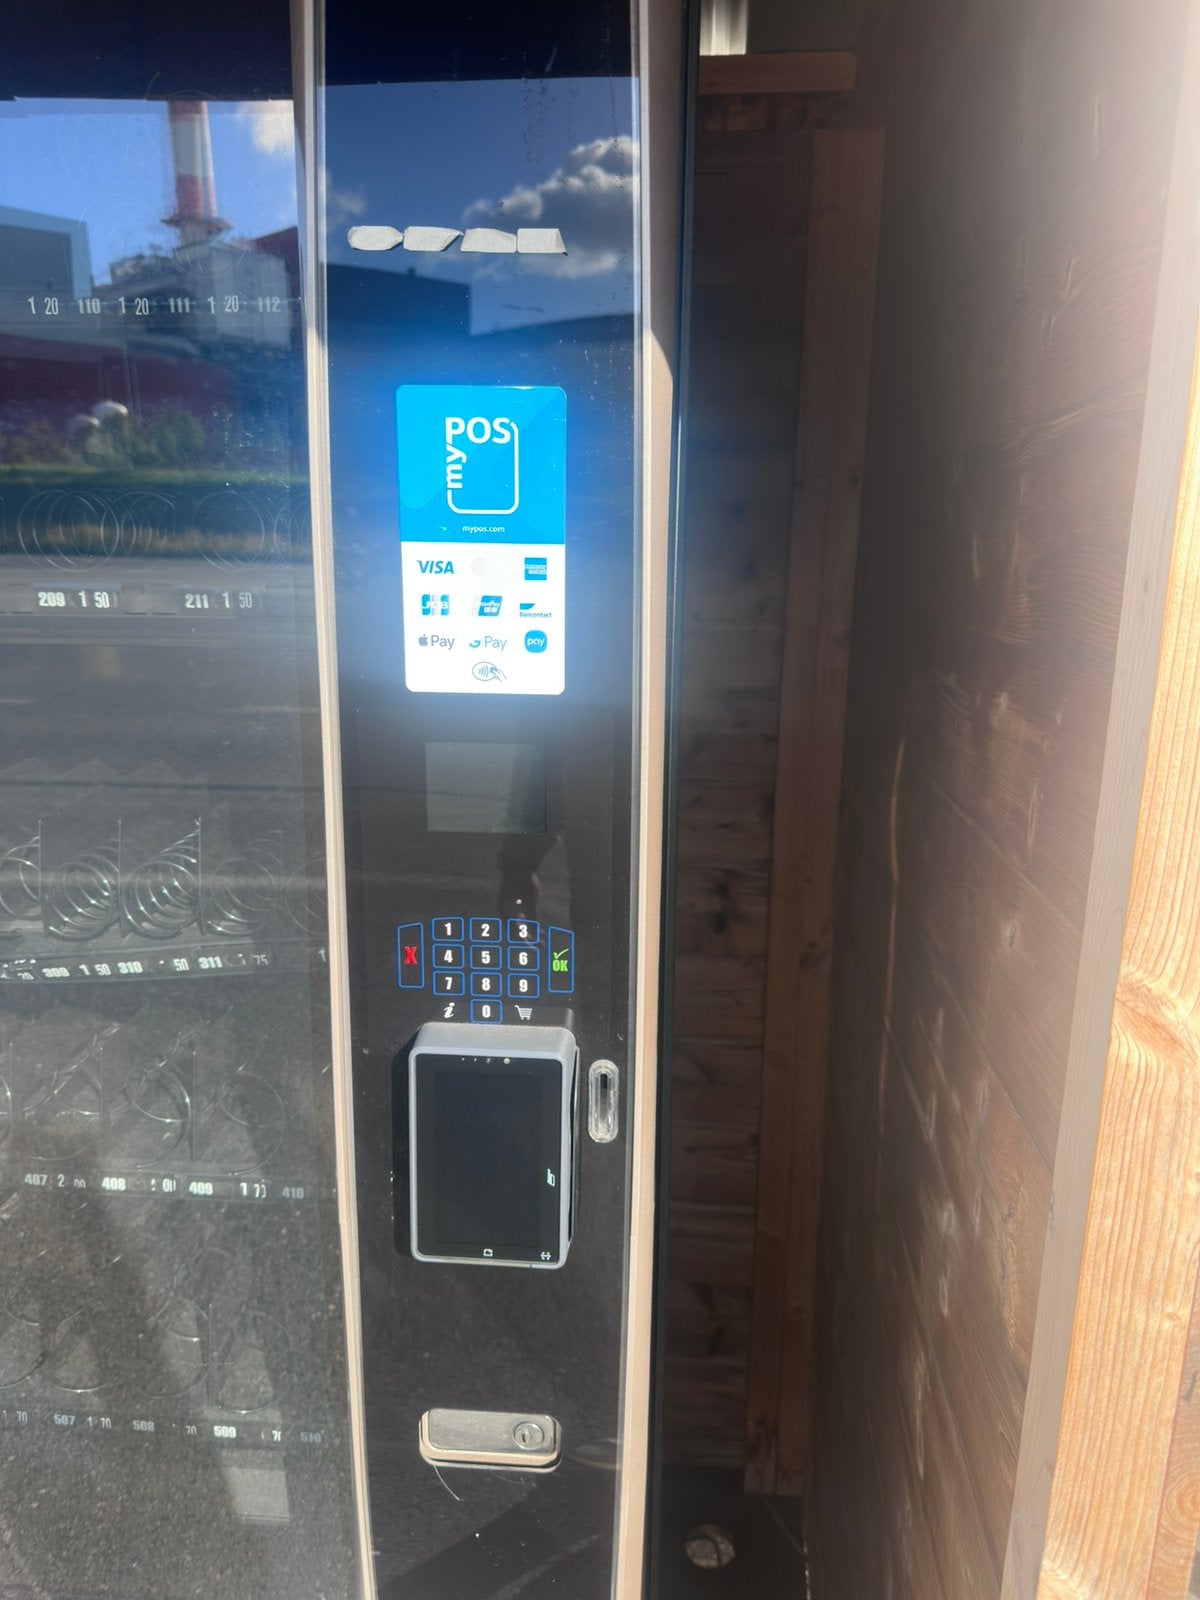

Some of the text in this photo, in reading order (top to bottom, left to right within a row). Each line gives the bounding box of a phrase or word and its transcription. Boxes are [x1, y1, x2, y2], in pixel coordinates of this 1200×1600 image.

[28, 296, 36, 315] 1
[44, 297, 59, 315] 20
[118, 296, 126, 314] 1
[135, 297, 150, 316] 20
[208, 297, 216, 314] 1
[225, 295, 239, 313] 20
[445, 416, 511, 444] POS
[446, 444, 467, 489] my
[462, 525, 505, 534] mypos.com
[416, 560, 454, 574] VISA
[38, 591, 110, 608] 209 1 50
[185, 592, 253, 609] 211 1 50
[430, 634, 455, 650] Pay
[484, 635, 507, 651] Pay
[444, 922, 452, 936] 1
[481, 924, 490, 937] 2
[518, 924, 528, 938] 3
[443, 949, 453, 963] 4
[481, 951, 491, 964] 5
[518, 951, 528, 966] 6
[79, 964, 90, 976] 1
[95, 963, 111, 976] 50
[117, 961, 143, 974] 310
[172, 958, 189, 971] 50
[198, 956, 223, 969] 311
[552, 959, 568, 972] OK
[445, 977, 452, 990] 7
[481, 978, 491, 991] 8
[518, 979, 528, 993] 9
[482, 1005, 491, 1019] 0
[57, 1174, 65, 1188] 2
[101, 1177, 126, 1191] 408
